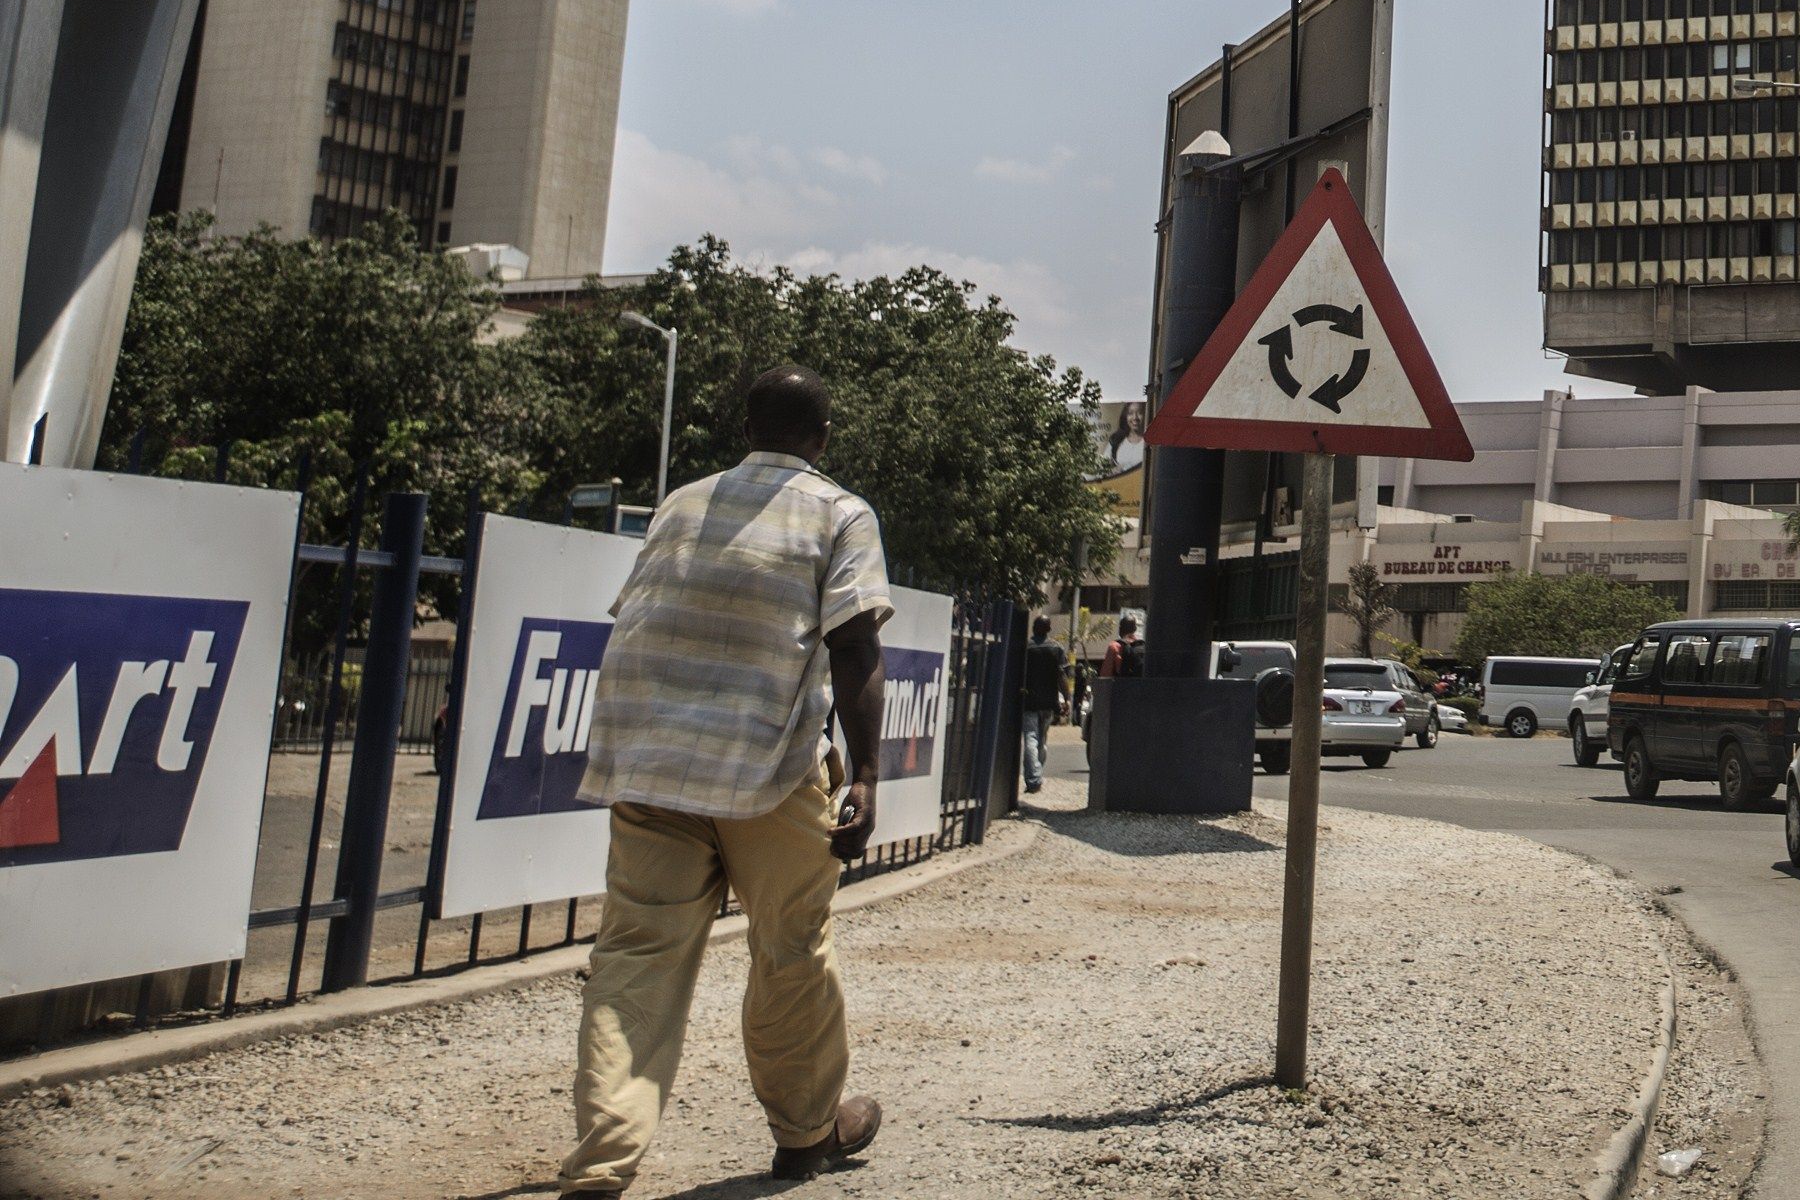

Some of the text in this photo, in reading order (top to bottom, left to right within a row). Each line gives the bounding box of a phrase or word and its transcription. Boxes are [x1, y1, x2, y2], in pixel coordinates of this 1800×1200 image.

[1433, 546, 1461, 559] APT
[1599, 552, 1687, 564] ENTERPRISES
[1383, 562, 1436, 576] BUREAU
[1437, 561, 1456, 574] DE
[1777, 563, 1796, 577] DE
